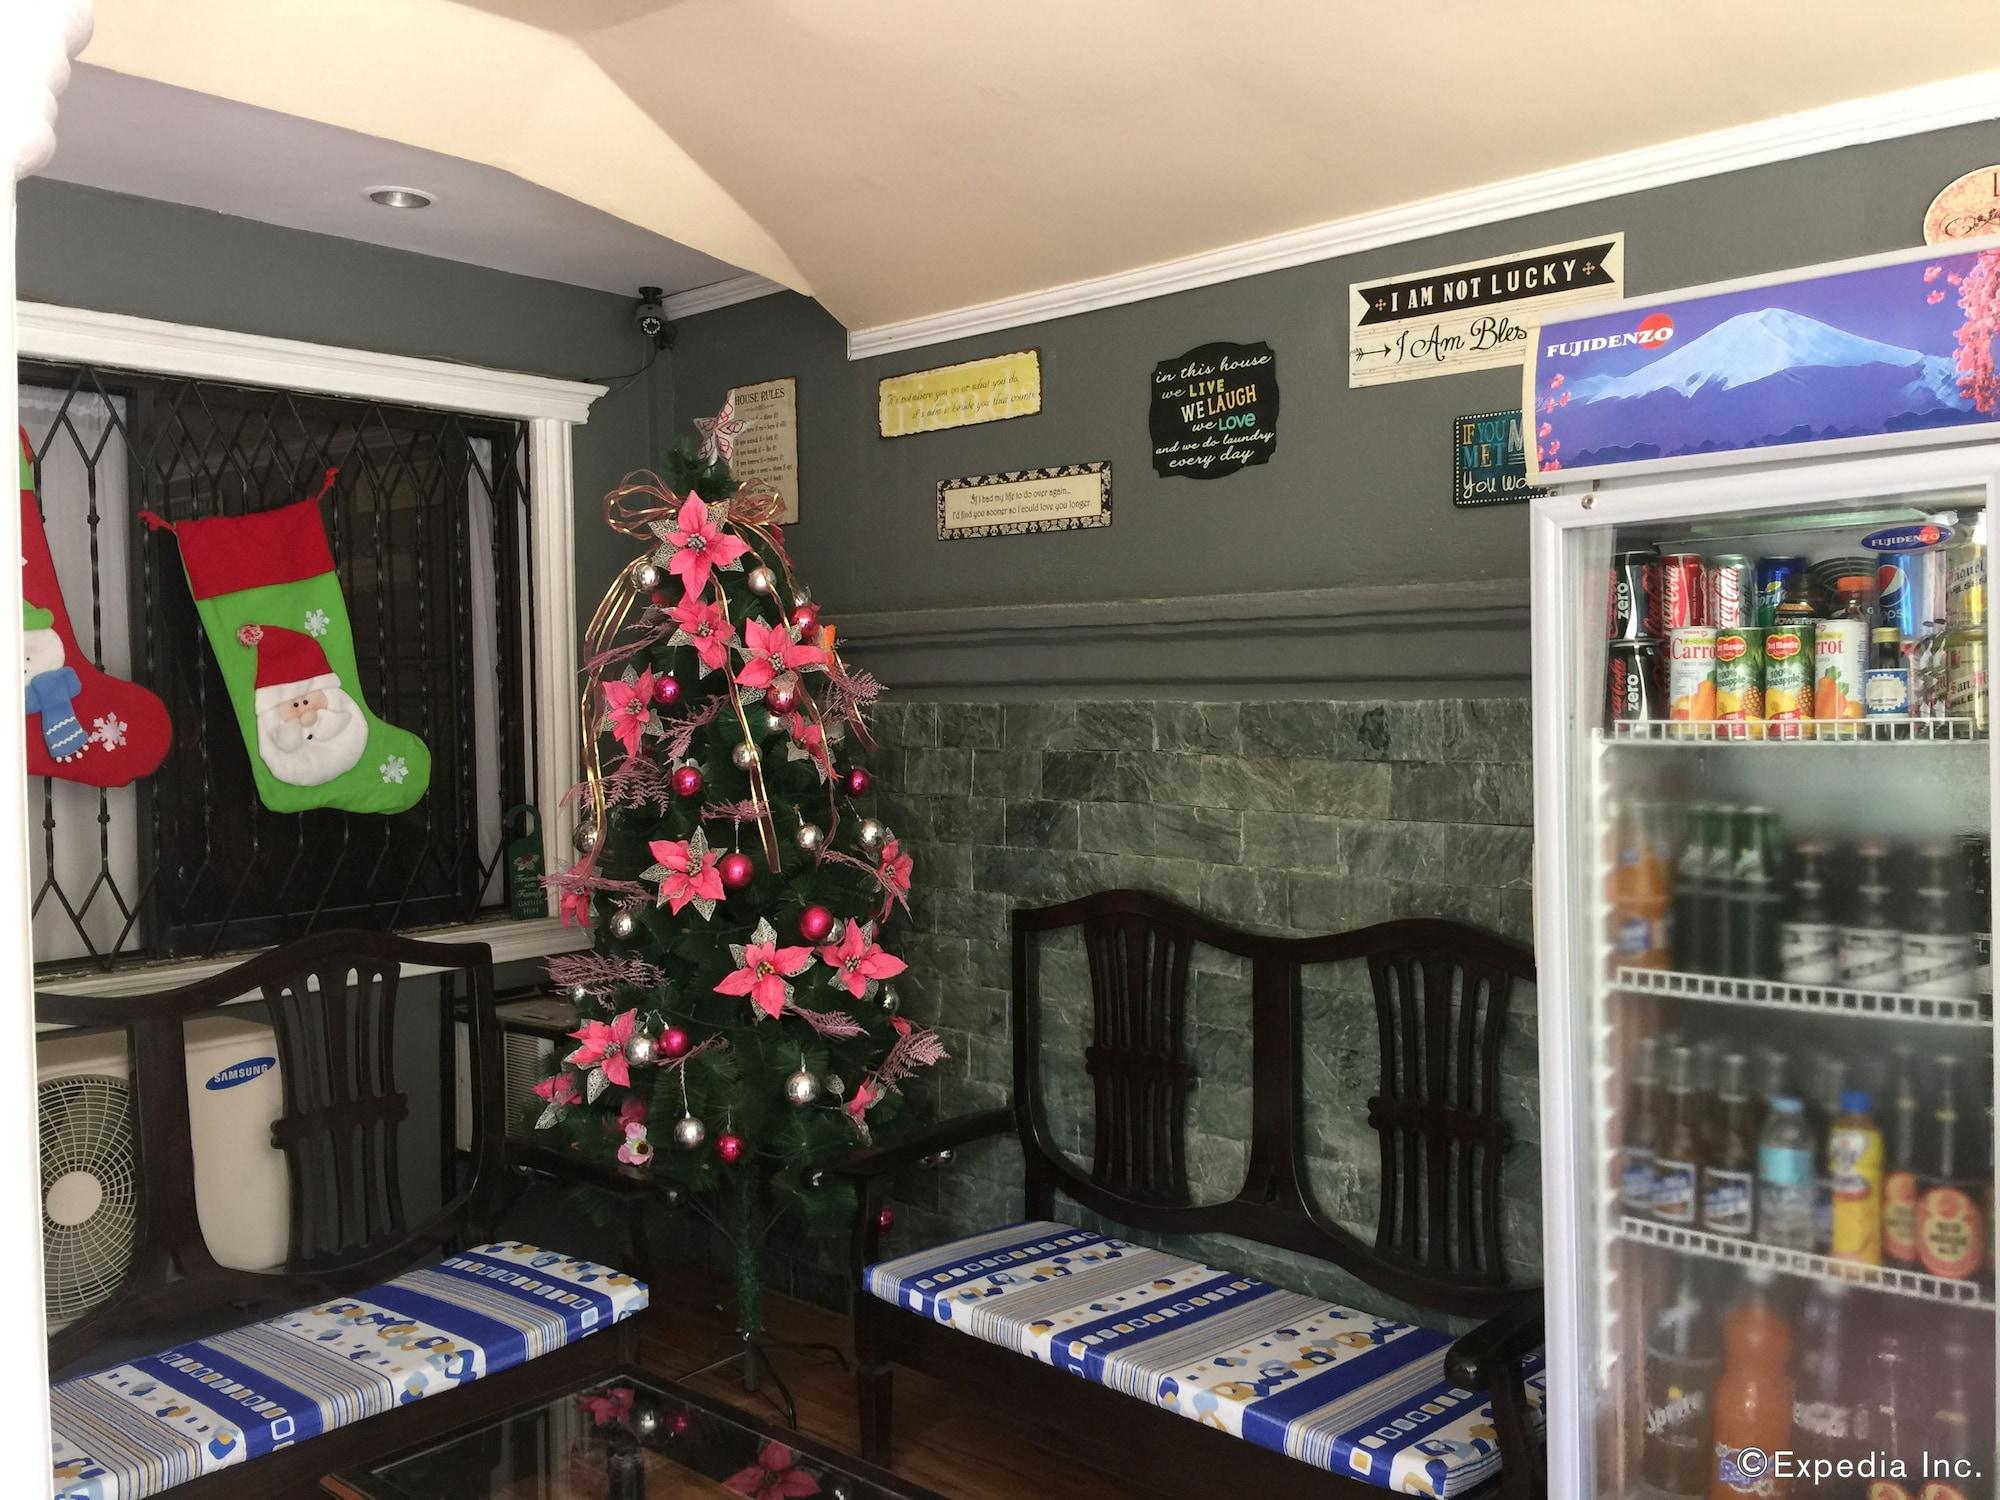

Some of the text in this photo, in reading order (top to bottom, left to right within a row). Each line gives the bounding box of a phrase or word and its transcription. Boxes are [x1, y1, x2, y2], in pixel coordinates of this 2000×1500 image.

[1391, 259, 1577, 312] I AM NOT LUCKY
[1410, 324, 1465, 362] Am
[1469, 316, 1527, 351] Bles
[1546, 326, 1674, 358] FUJIDENZO
[1155, 355, 1272, 384] in this house
[735, 388, 785, 405] HOUSE RULES
[1161, 378, 1225, 400] we LIVE
[1180, 384, 1257, 423] WE LAUGH
[1192, 421, 1217, 432] we
[1462, 423, 1476, 445] IF
[1477, 420, 1506, 443] YOU
[1155, 429, 1275, 455] and we do laundry
[1168, 445, 1255, 469] every day
[1462, 442, 1505, 469] MET
[1023, 490, 1032, 499] do
[1033, 490, 1047, 498] over
[986, 508, 1008, 516] sooner
[1021, 503, 1039, 513] could
[1040, 503, 1054, 511] love
[1055, 502, 1067, 511] you
[1871, 533, 1940, 547] FUJIDENZO
[1617, 582, 1629, 620] zero
[1672, 637, 1716, 660] Carro
[1816, 640, 1844, 655] rrot
[1627, 674, 1639, 712] zero
[214, 1063, 268, 1083] SAMSUNG
